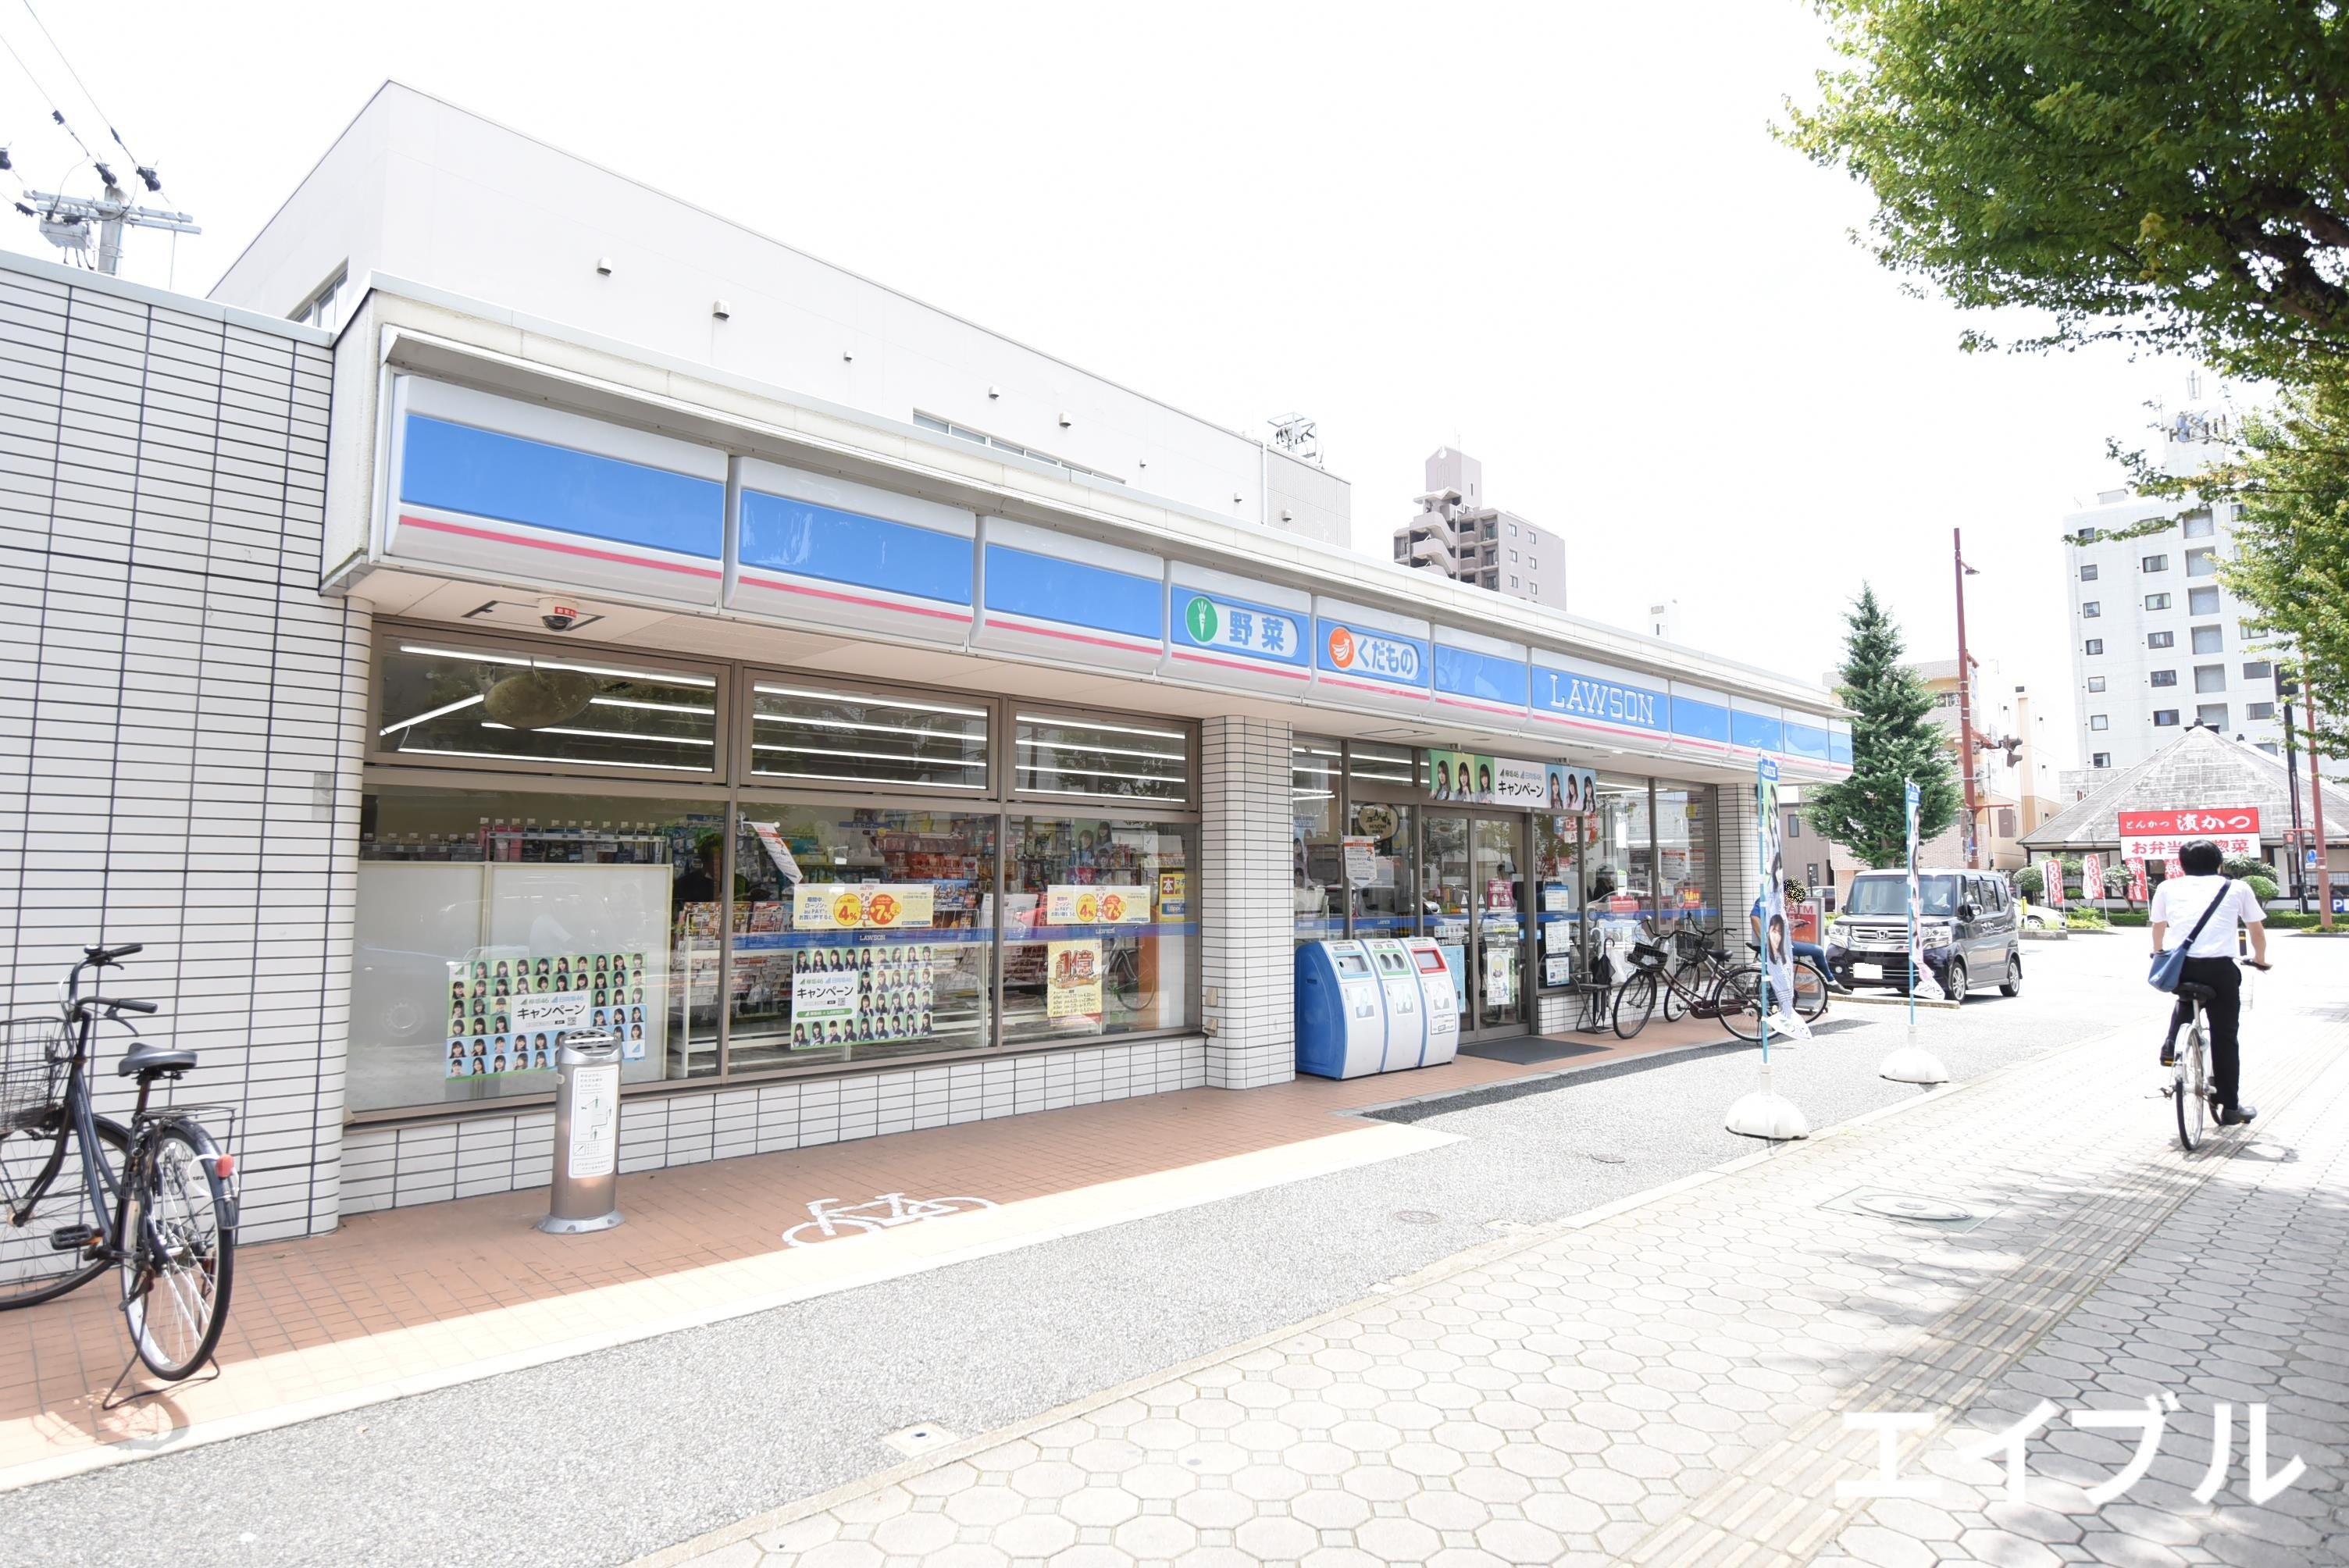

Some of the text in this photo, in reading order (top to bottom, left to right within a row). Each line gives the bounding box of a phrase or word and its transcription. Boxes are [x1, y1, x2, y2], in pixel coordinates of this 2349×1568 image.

[1229, 610, 1285, 652] 野菜
[1357, 638, 1413, 675] くだもの
[1549, 673, 1655, 725] LAWSON
[1498, 780, 1544, 798] キャンペーン
[2126, 821, 2170, 830] とんかつ
[1163, 877, 1174, 893] 本
[839, 905, 857, 921] 4%
[1788, 905, 1813, 914] ATM
[797, 985, 854, 1000] キャンペーン
[517, 1004, 586, 1020] キャンペーン
